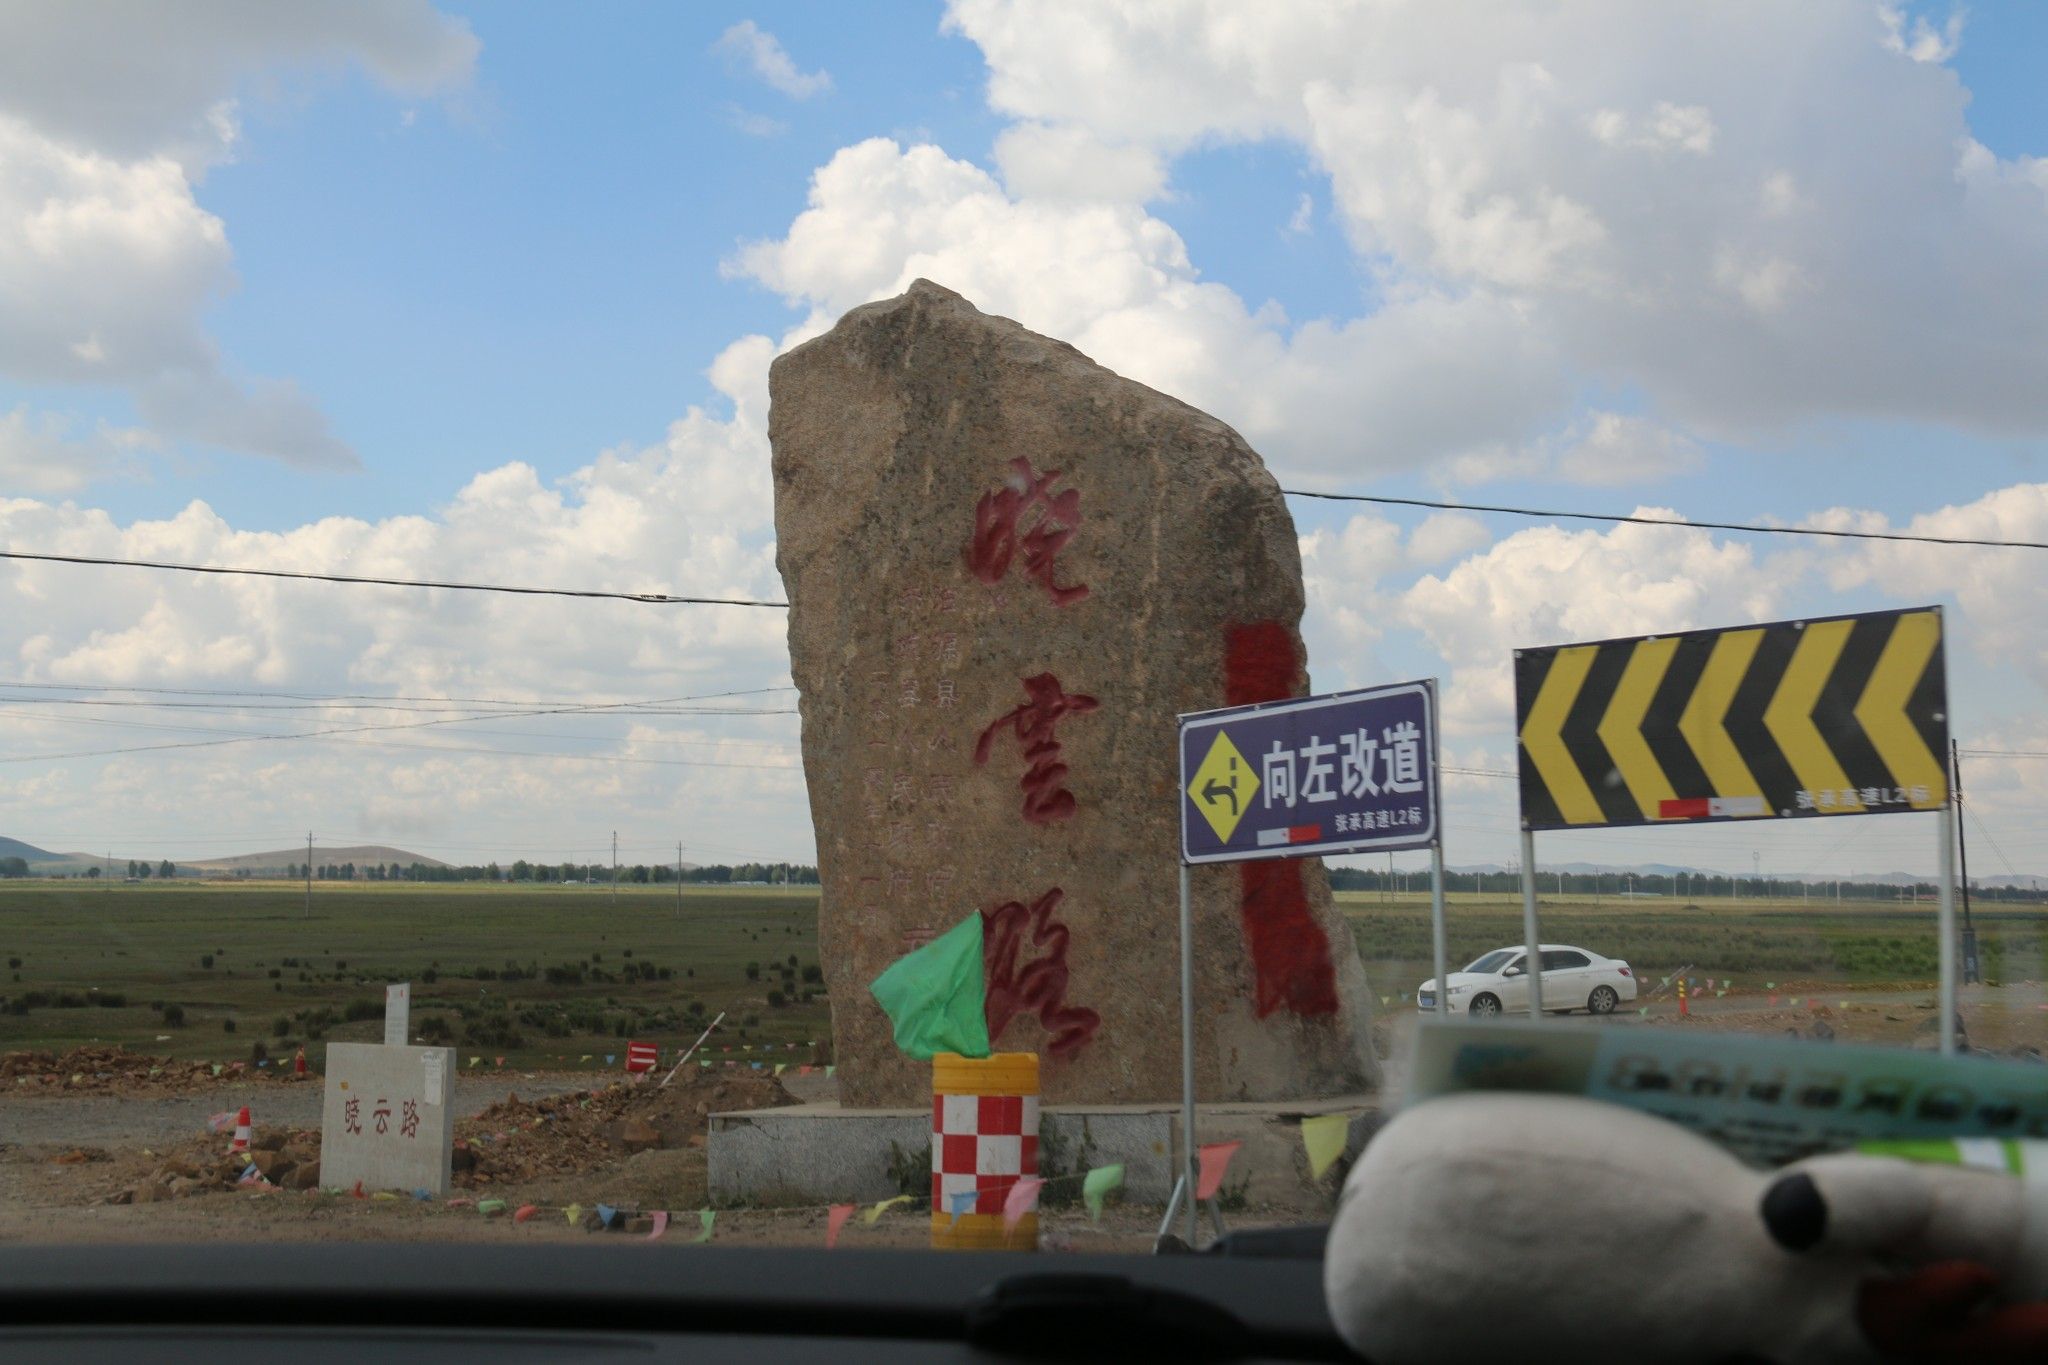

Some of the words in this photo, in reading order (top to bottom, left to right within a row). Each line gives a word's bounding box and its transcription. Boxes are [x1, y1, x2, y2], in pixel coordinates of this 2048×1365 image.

[1263, 721, 1424, 809] 向左改道
[1335, 807, 1422, 832] 张承高速L2标
[345, 1094, 419, 1138] 晓云路
